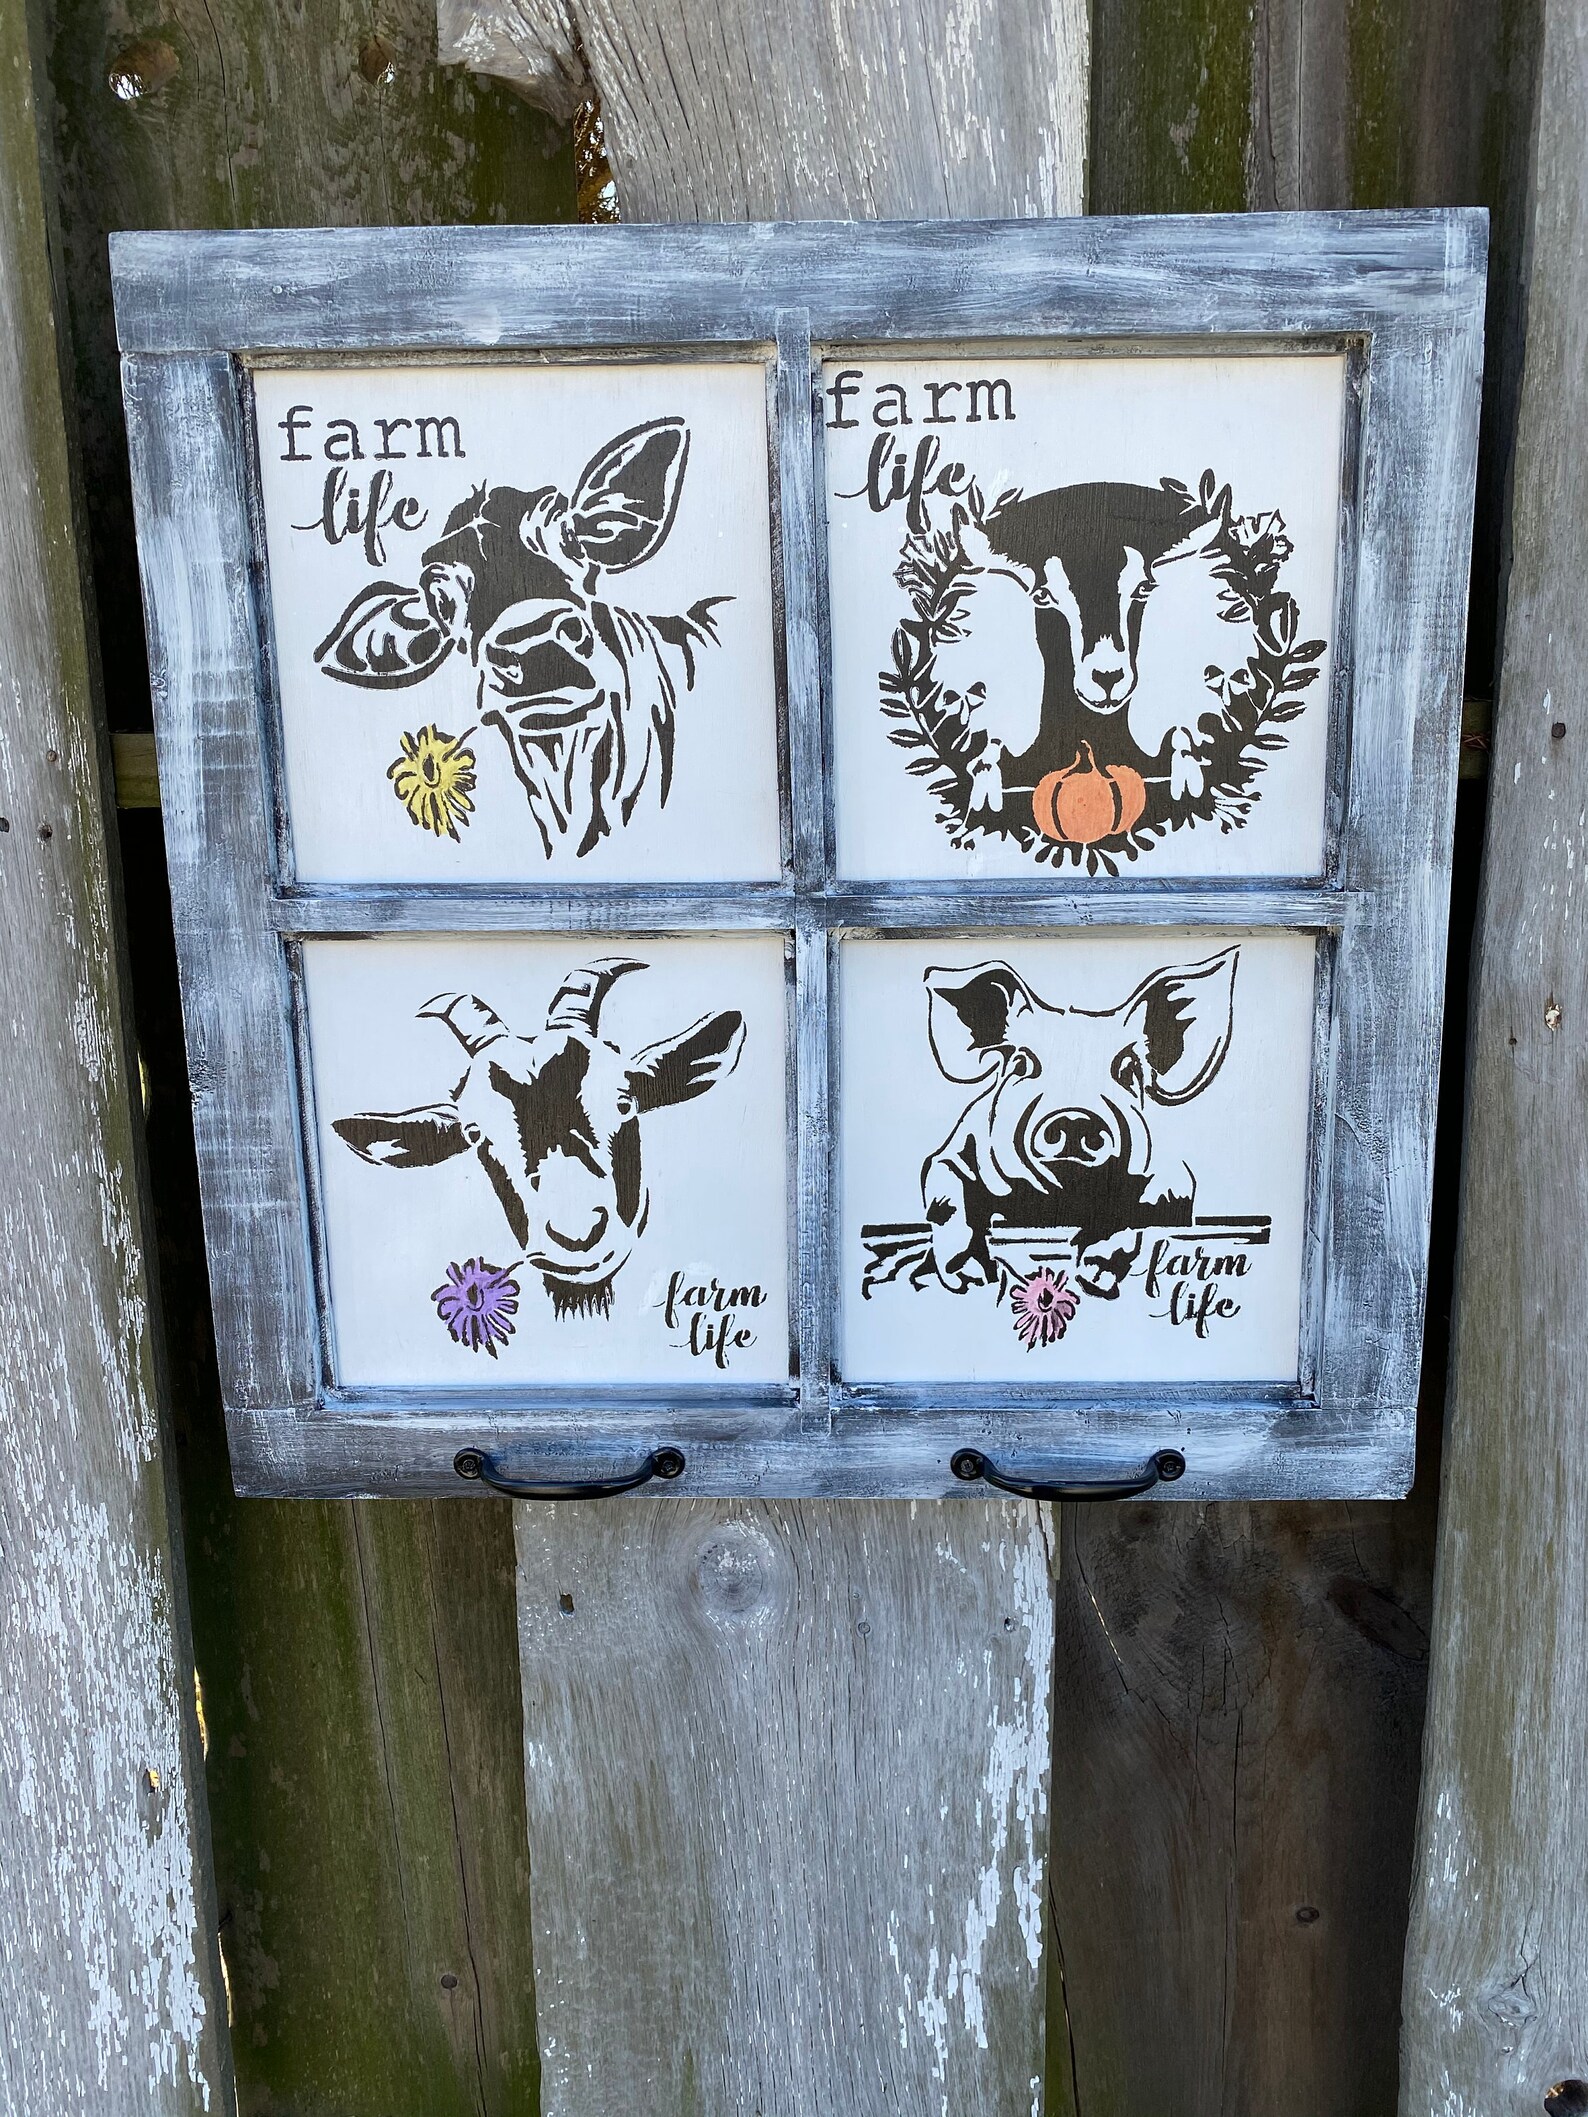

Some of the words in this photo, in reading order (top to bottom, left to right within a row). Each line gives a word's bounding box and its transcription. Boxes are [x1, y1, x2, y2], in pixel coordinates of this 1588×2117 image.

[826, 370, 1016, 429] farm
[278, 405, 466, 461] farm
[834, 432, 976, 534] life
[290, 466, 429, 567] life
[1129, 1239, 1252, 1298] farm
[652, 1271, 768, 1329] farm
[1148, 1281, 1241, 1339] life
[669, 1312, 757, 1369] life
